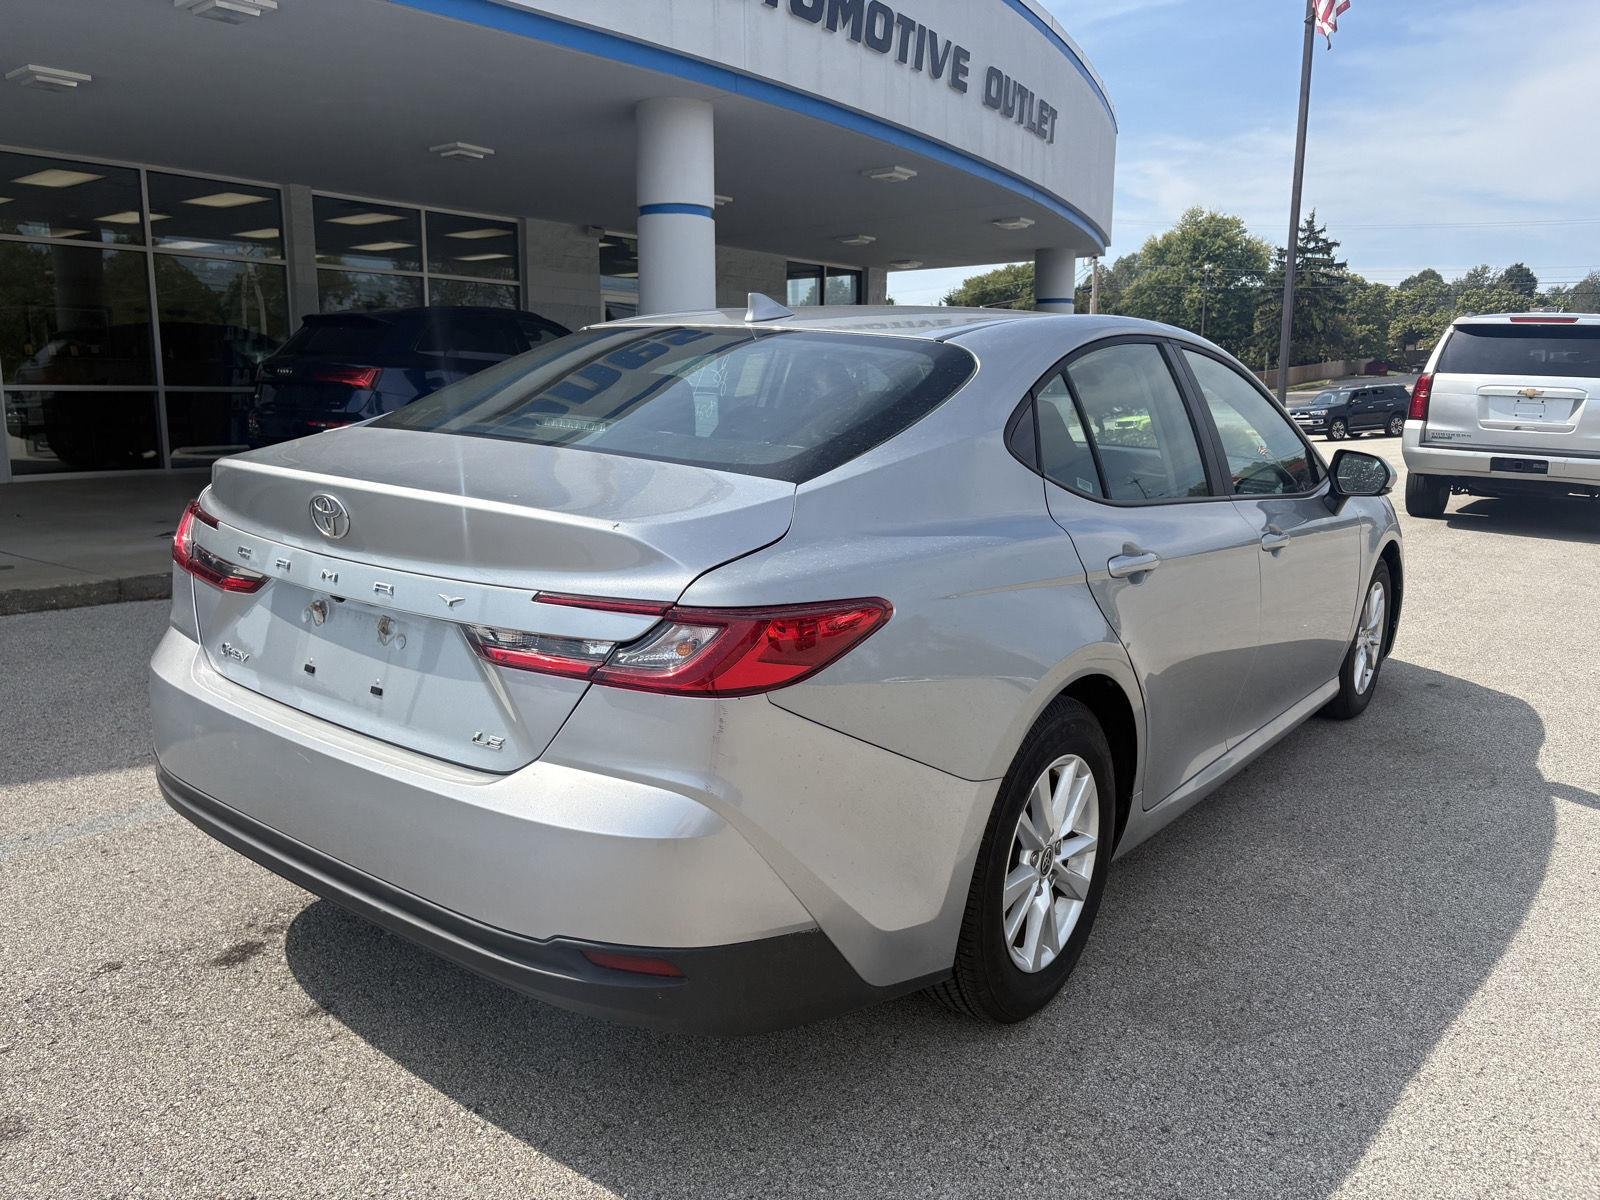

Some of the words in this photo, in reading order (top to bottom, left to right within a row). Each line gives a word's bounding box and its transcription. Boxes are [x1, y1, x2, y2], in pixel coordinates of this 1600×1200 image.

[762, 0, 970, 94] MOTIVE
[984, 65, 1058, 144] OUTLET
[471, 731, 505, 751] LE
